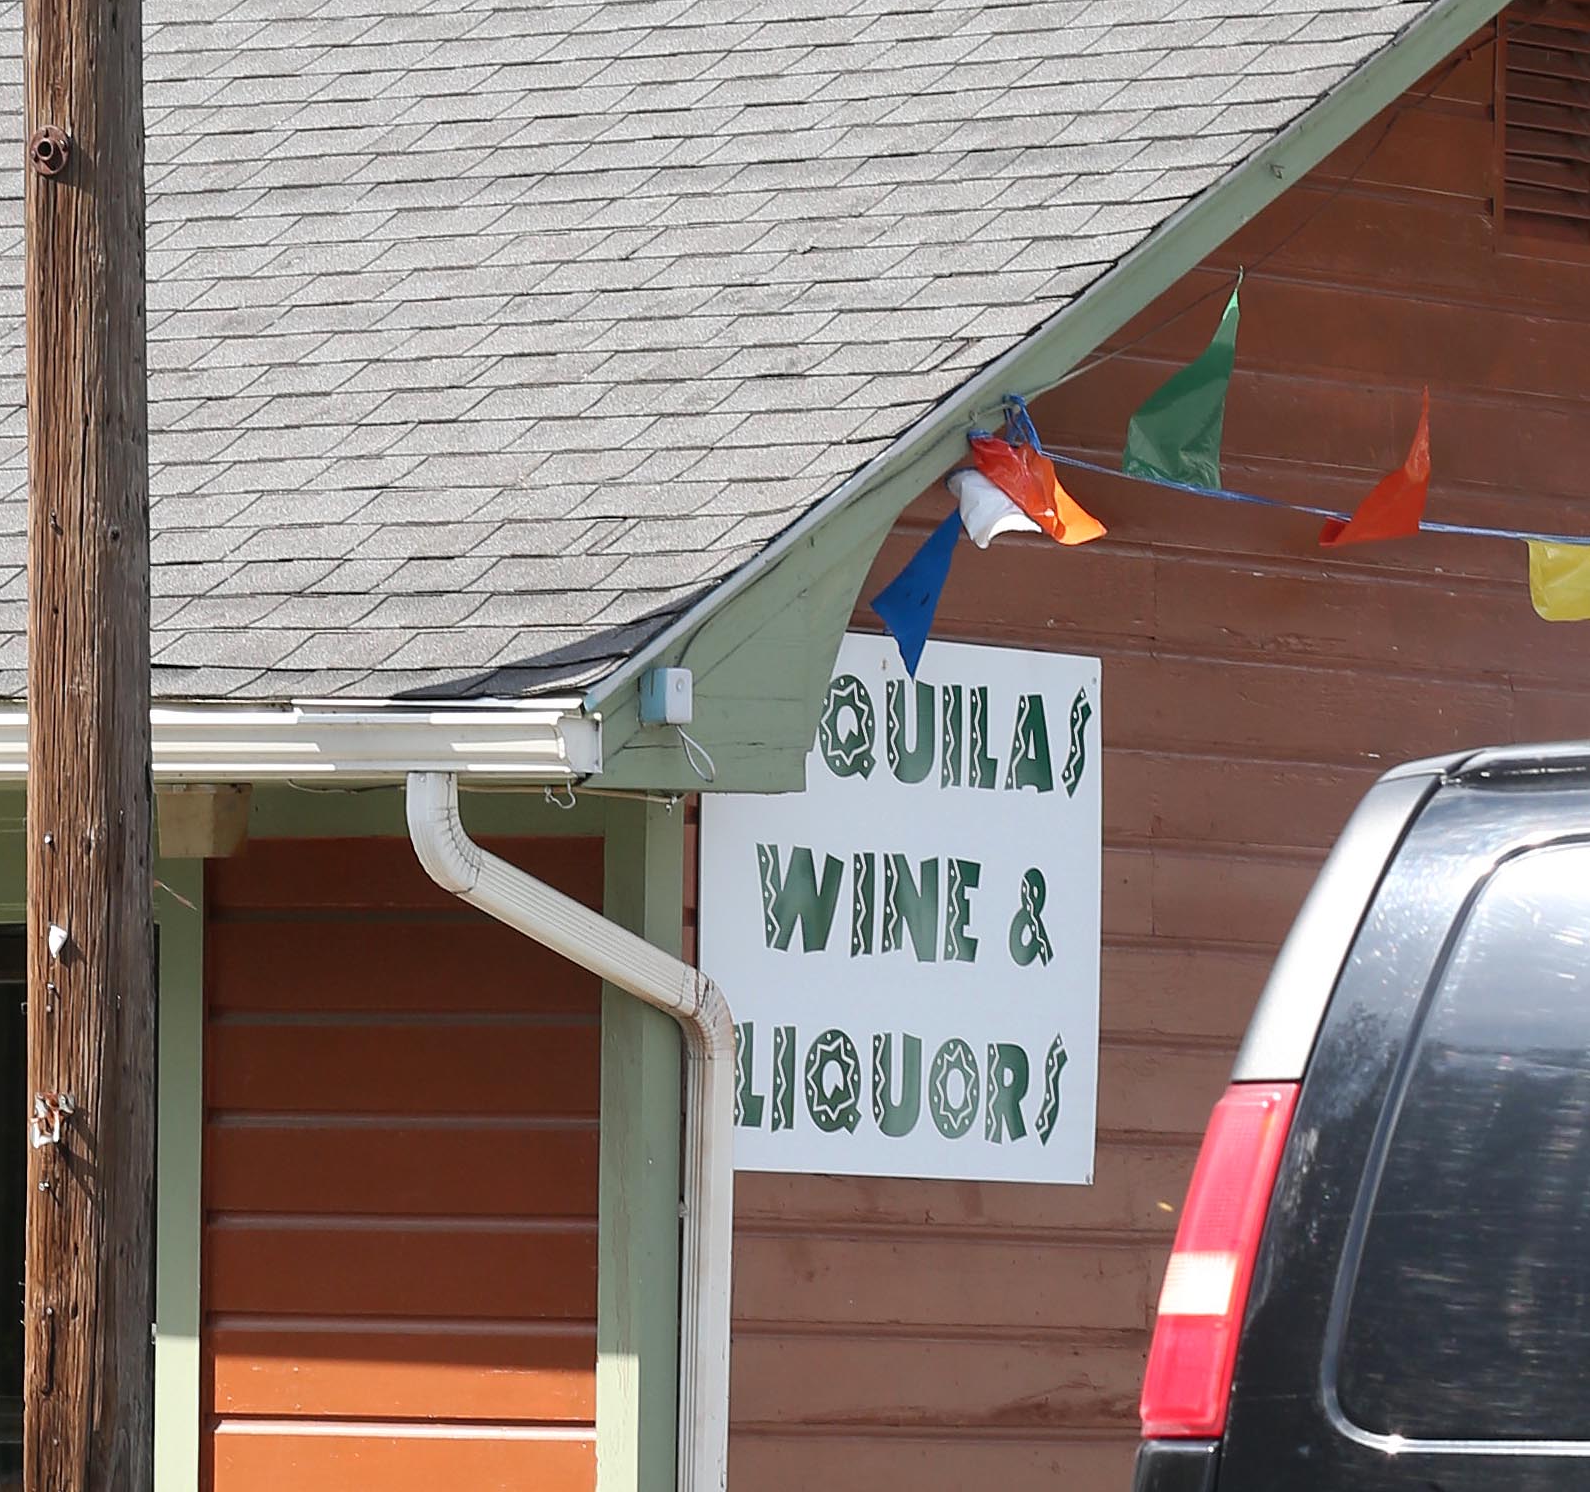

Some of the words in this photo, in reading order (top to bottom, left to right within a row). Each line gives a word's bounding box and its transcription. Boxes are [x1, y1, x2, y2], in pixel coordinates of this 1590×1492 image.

[818, 674, 1092, 799] QUILAS
[755, 842, 981, 963] WINE
[1008, 867, 1053, 967] &
[734, 1020, 1068, 1146] LIQUORS
